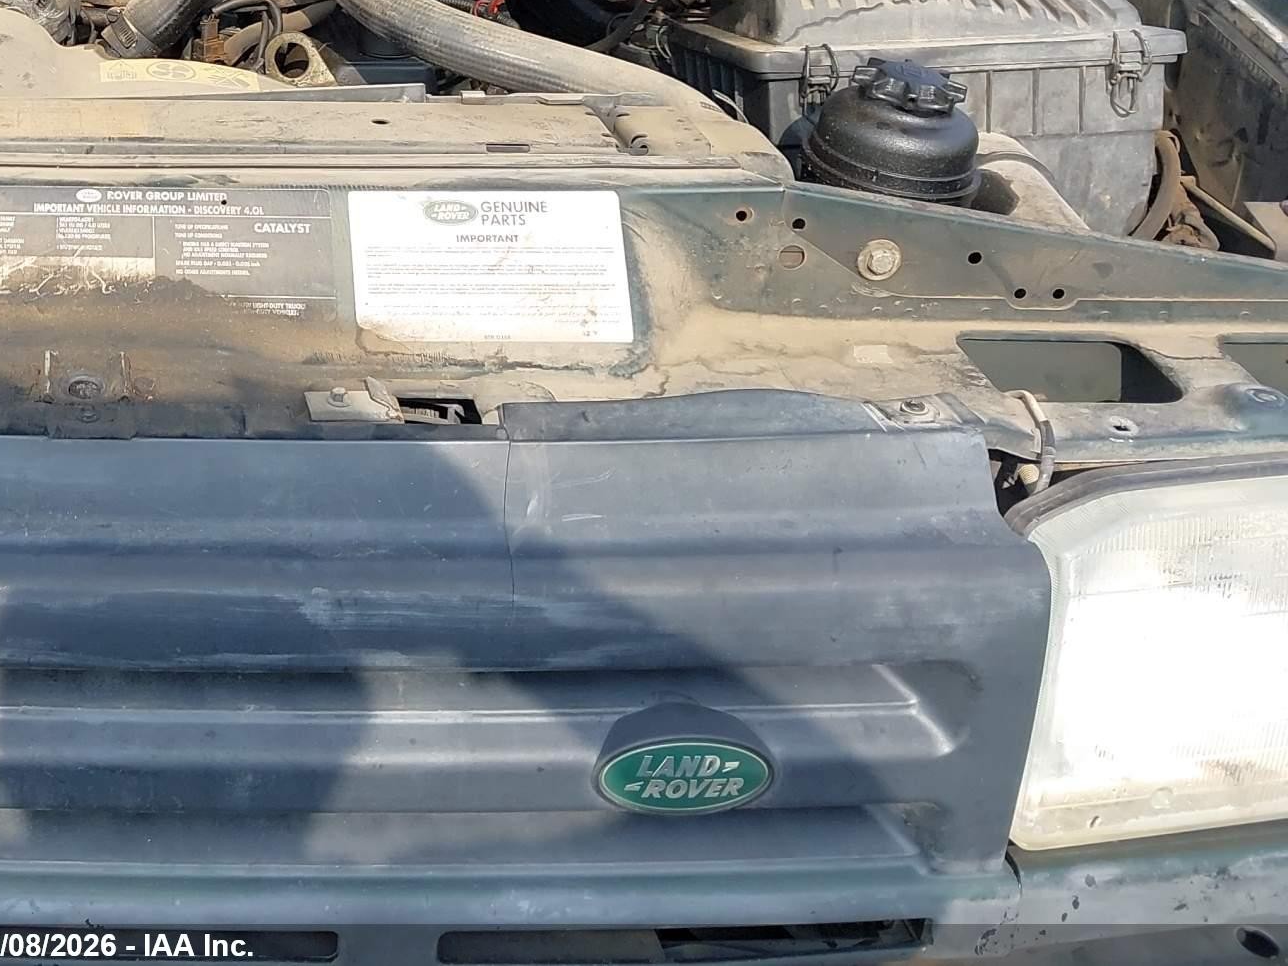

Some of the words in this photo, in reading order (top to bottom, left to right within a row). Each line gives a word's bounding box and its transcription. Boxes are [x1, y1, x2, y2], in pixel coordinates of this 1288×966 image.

[107, 191, 142, 200] ROVER
[146, 192, 184, 201] GROUP
[187, 192, 227, 202] LIMITED
[34, 203, 84, 213] IMPORTANT
[87, 204, 120, 213] VEHICLE
[122, 205, 186, 214] INFORMATION
[194, 206, 241, 214] DISCOVERY
[244, 206, 264, 215] 4.0L
[434, 203, 461, 212] LAND
[480, 201, 548, 213] GENUINE
[438, 212, 469, 220] ROVER
[482, 214, 526, 226] PARTS
[254, 223, 311, 234] CATALYST
[456, 234, 519, 243] IMPORTANT
